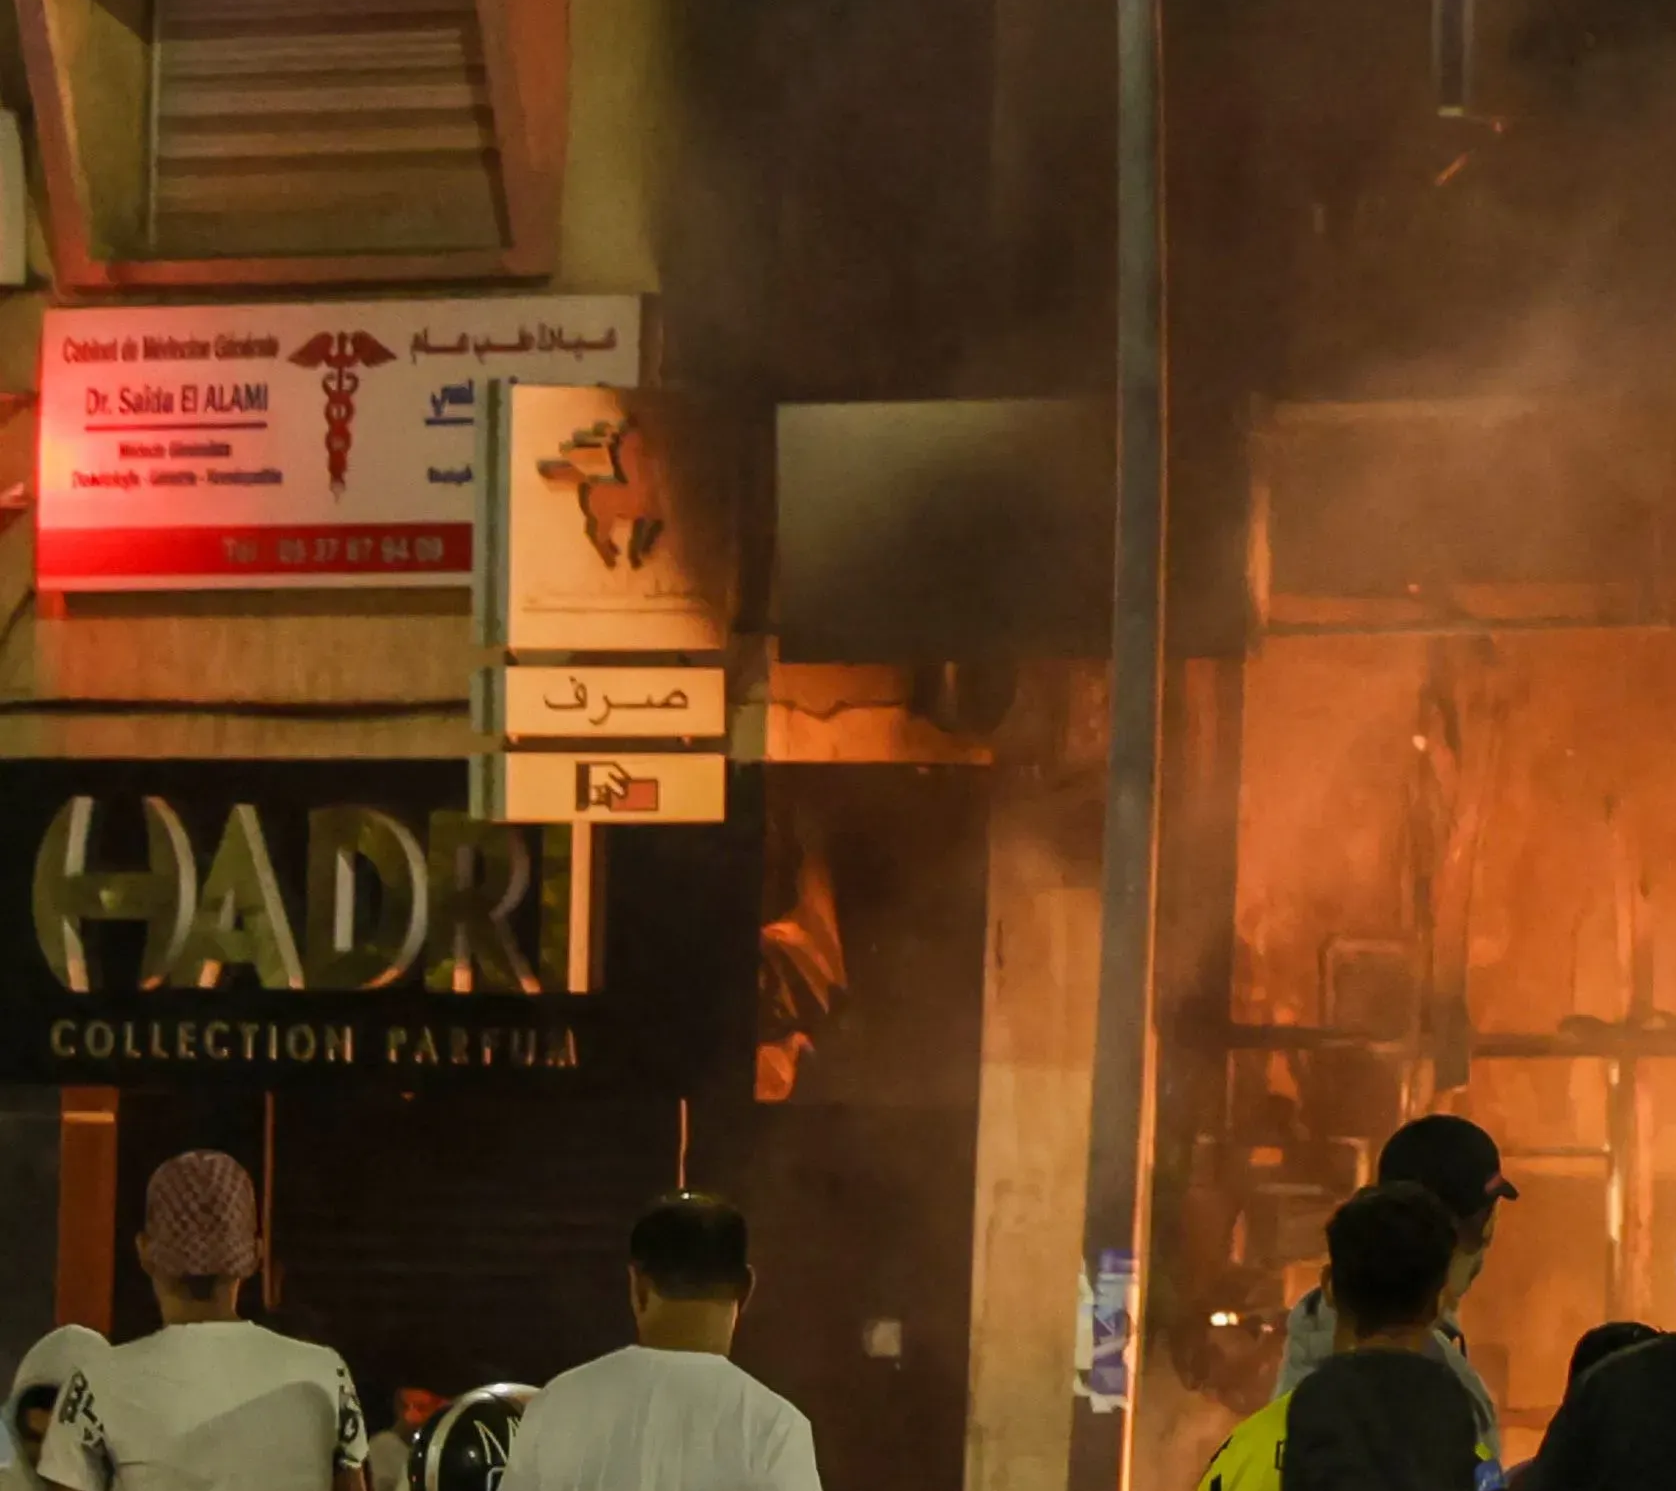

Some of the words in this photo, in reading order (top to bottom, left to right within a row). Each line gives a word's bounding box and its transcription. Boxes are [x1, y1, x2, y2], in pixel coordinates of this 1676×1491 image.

[204, 382, 269, 413] ALAMI
[543, 676, 689, 726] صرف
[50, 1018, 354, 1065] COLLECTION
[386, 1024, 579, 1068] PARFUM
